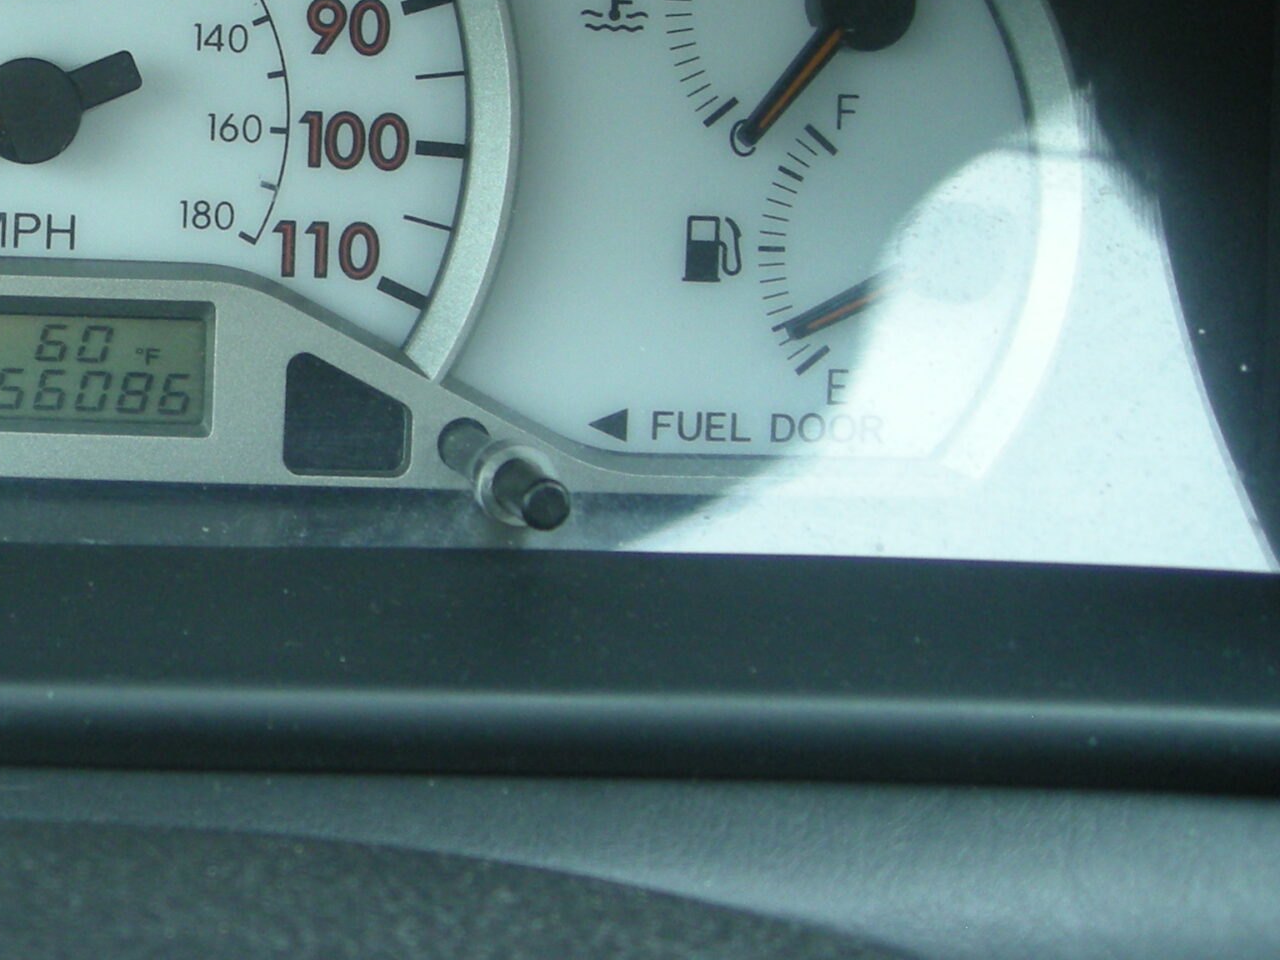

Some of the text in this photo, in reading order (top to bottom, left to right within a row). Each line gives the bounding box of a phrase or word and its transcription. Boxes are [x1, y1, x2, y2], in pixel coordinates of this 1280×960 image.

[194, 23, 249, 53] 140
[208, 113, 263, 144] 160
[837, 94, 859, 130] F
[299, 110, 410, 172] 100
[180, 200, 235, 231] 180
[272, 219, 380, 280] 110
[34, 324, 115, 363] 60
[827, 368, 849, 405] E
[651, 411, 884, 443] FUEL DOOR
